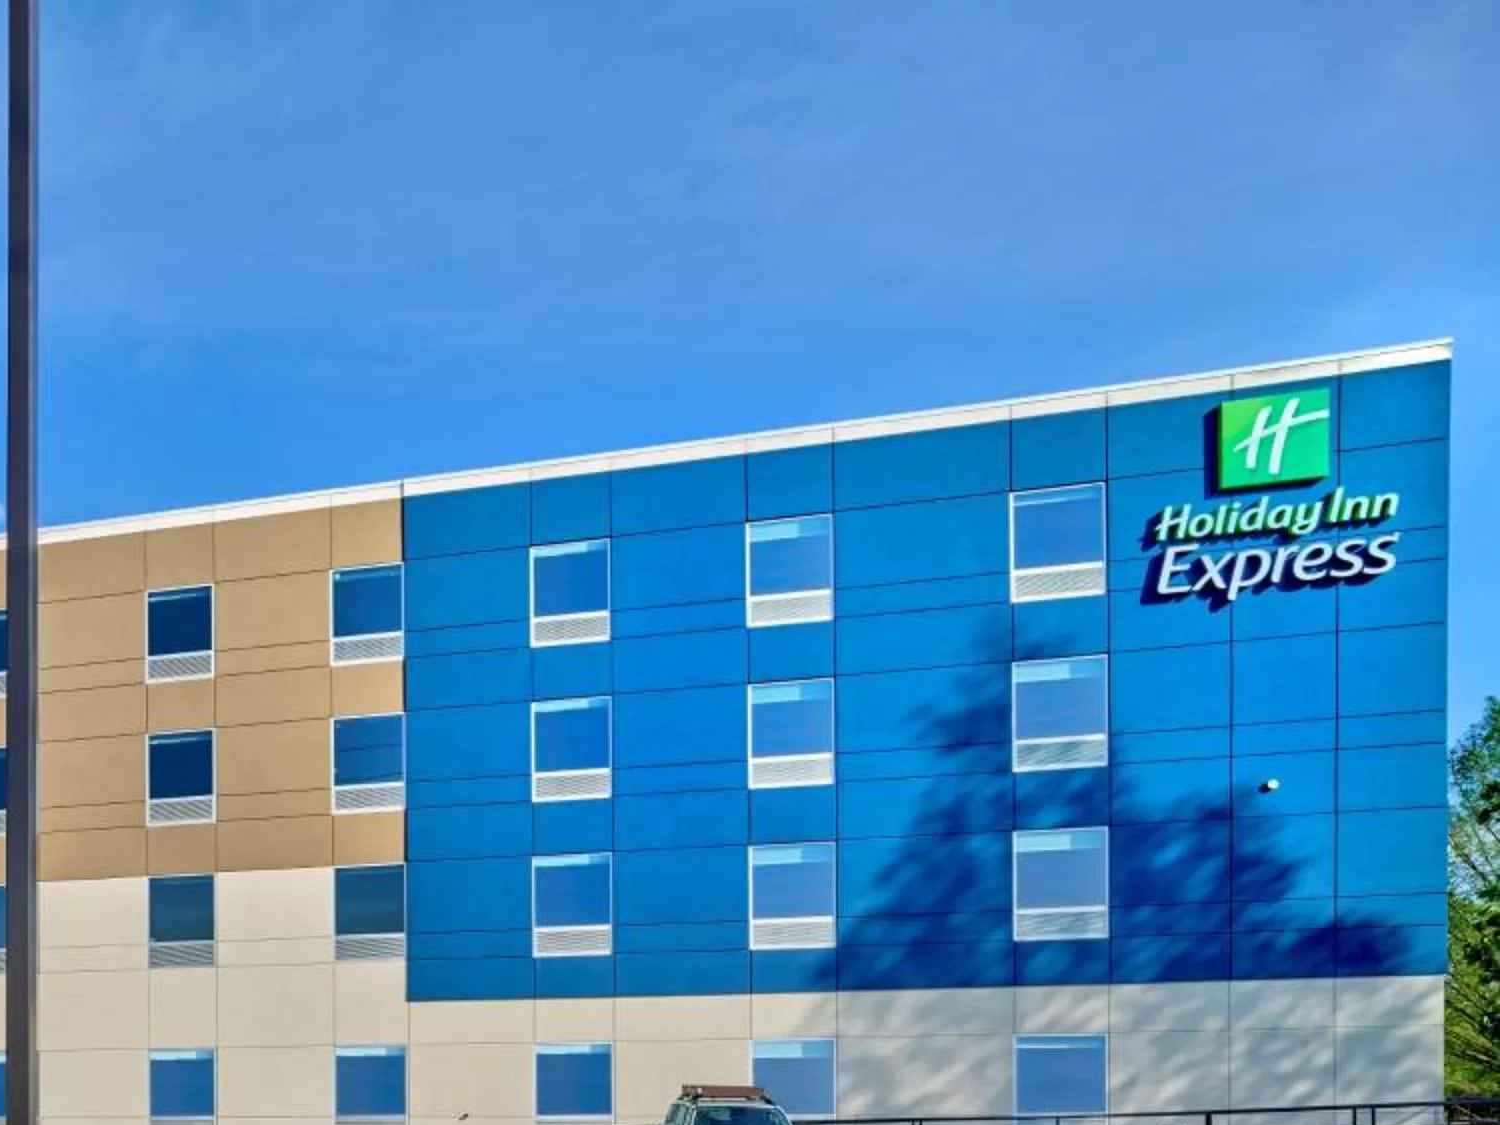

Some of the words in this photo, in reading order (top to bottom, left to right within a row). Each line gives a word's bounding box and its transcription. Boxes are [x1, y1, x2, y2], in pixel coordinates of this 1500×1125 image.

[1155, 496, 1324, 541] Holiday
[1327, 486, 1399, 523] Inn
[1156, 532, 1400, 600] Express
